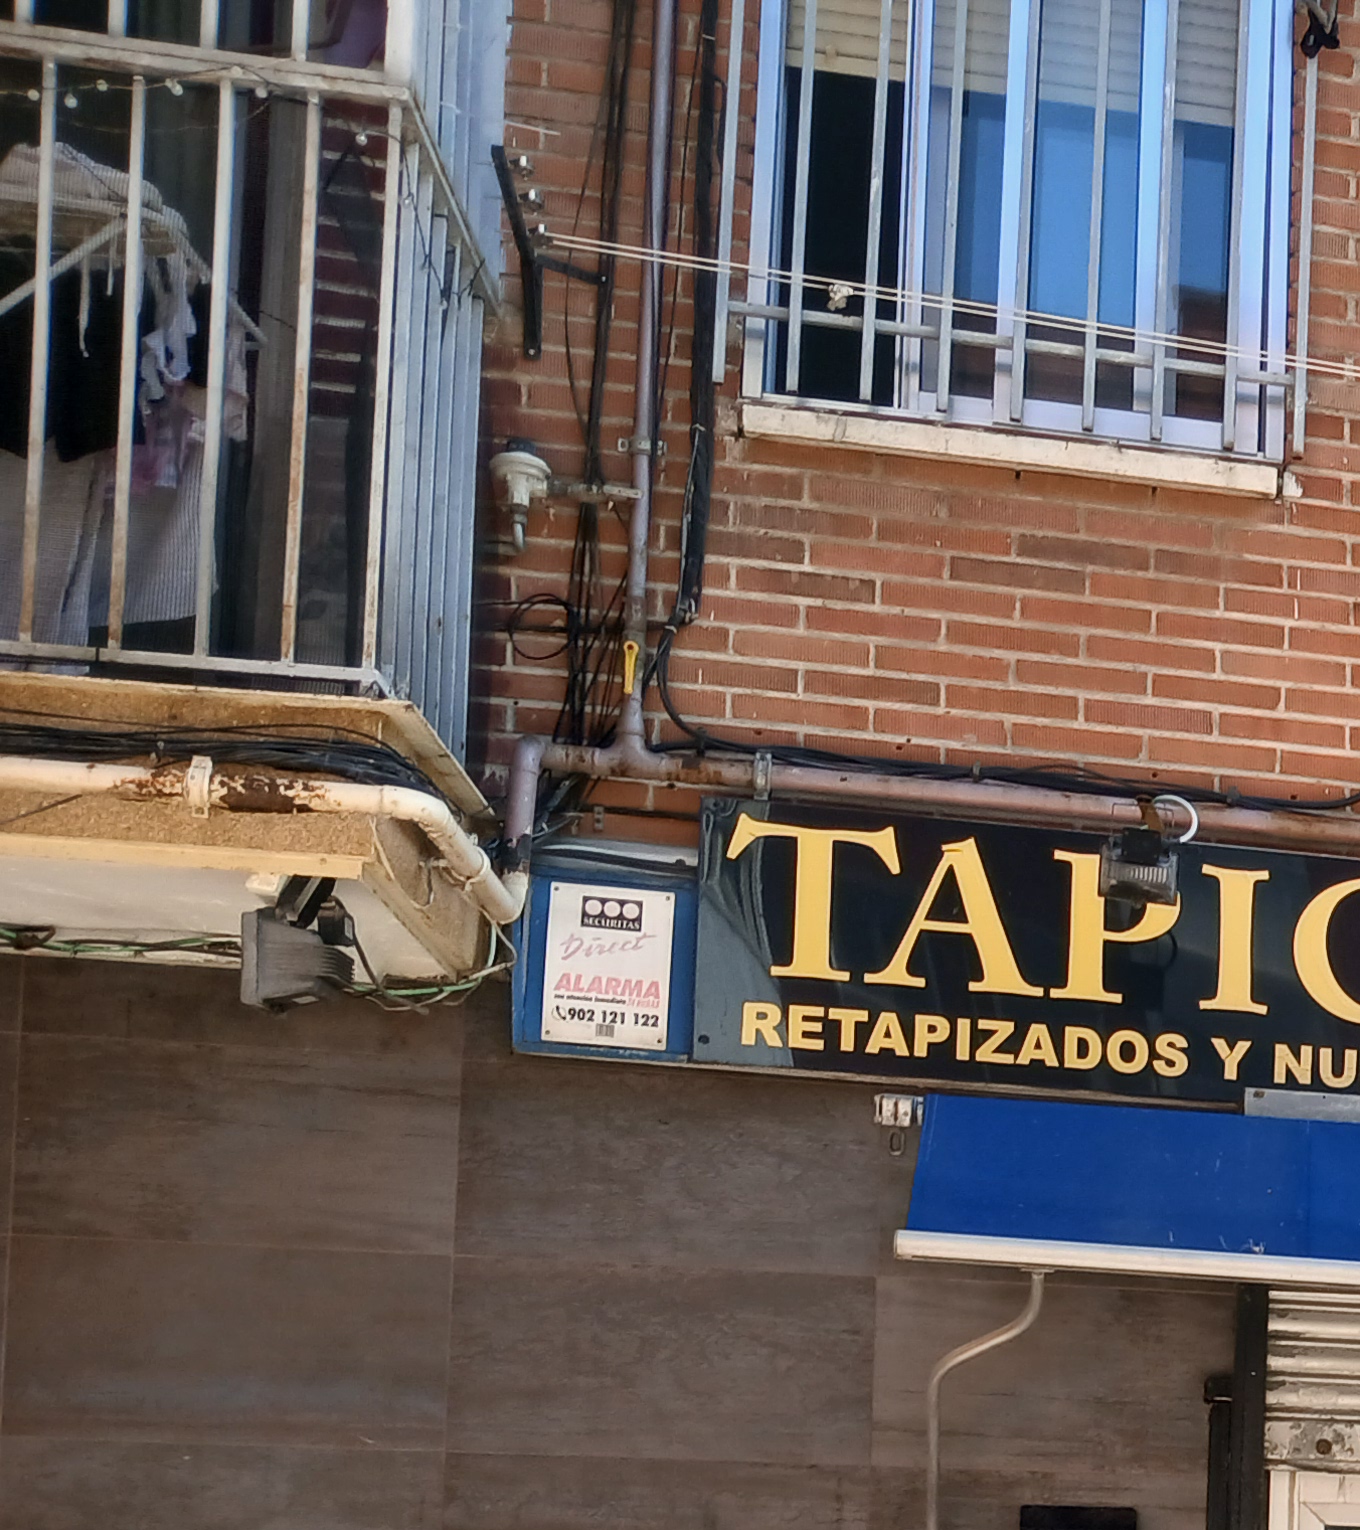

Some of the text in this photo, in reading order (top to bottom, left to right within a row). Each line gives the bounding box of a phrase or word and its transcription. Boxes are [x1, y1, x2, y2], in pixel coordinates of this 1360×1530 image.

[583, 916, 640, 930] SECURITAS
[560, 932, 657, 961] Direct
[553, 972, 661, 999] ALARMA
[568, 1007, 659, 1028] 902 121 122
[741, 1002, 1188, 1077] RETAPIZADOS
[1211, 1038, 1251, 1081] Y
